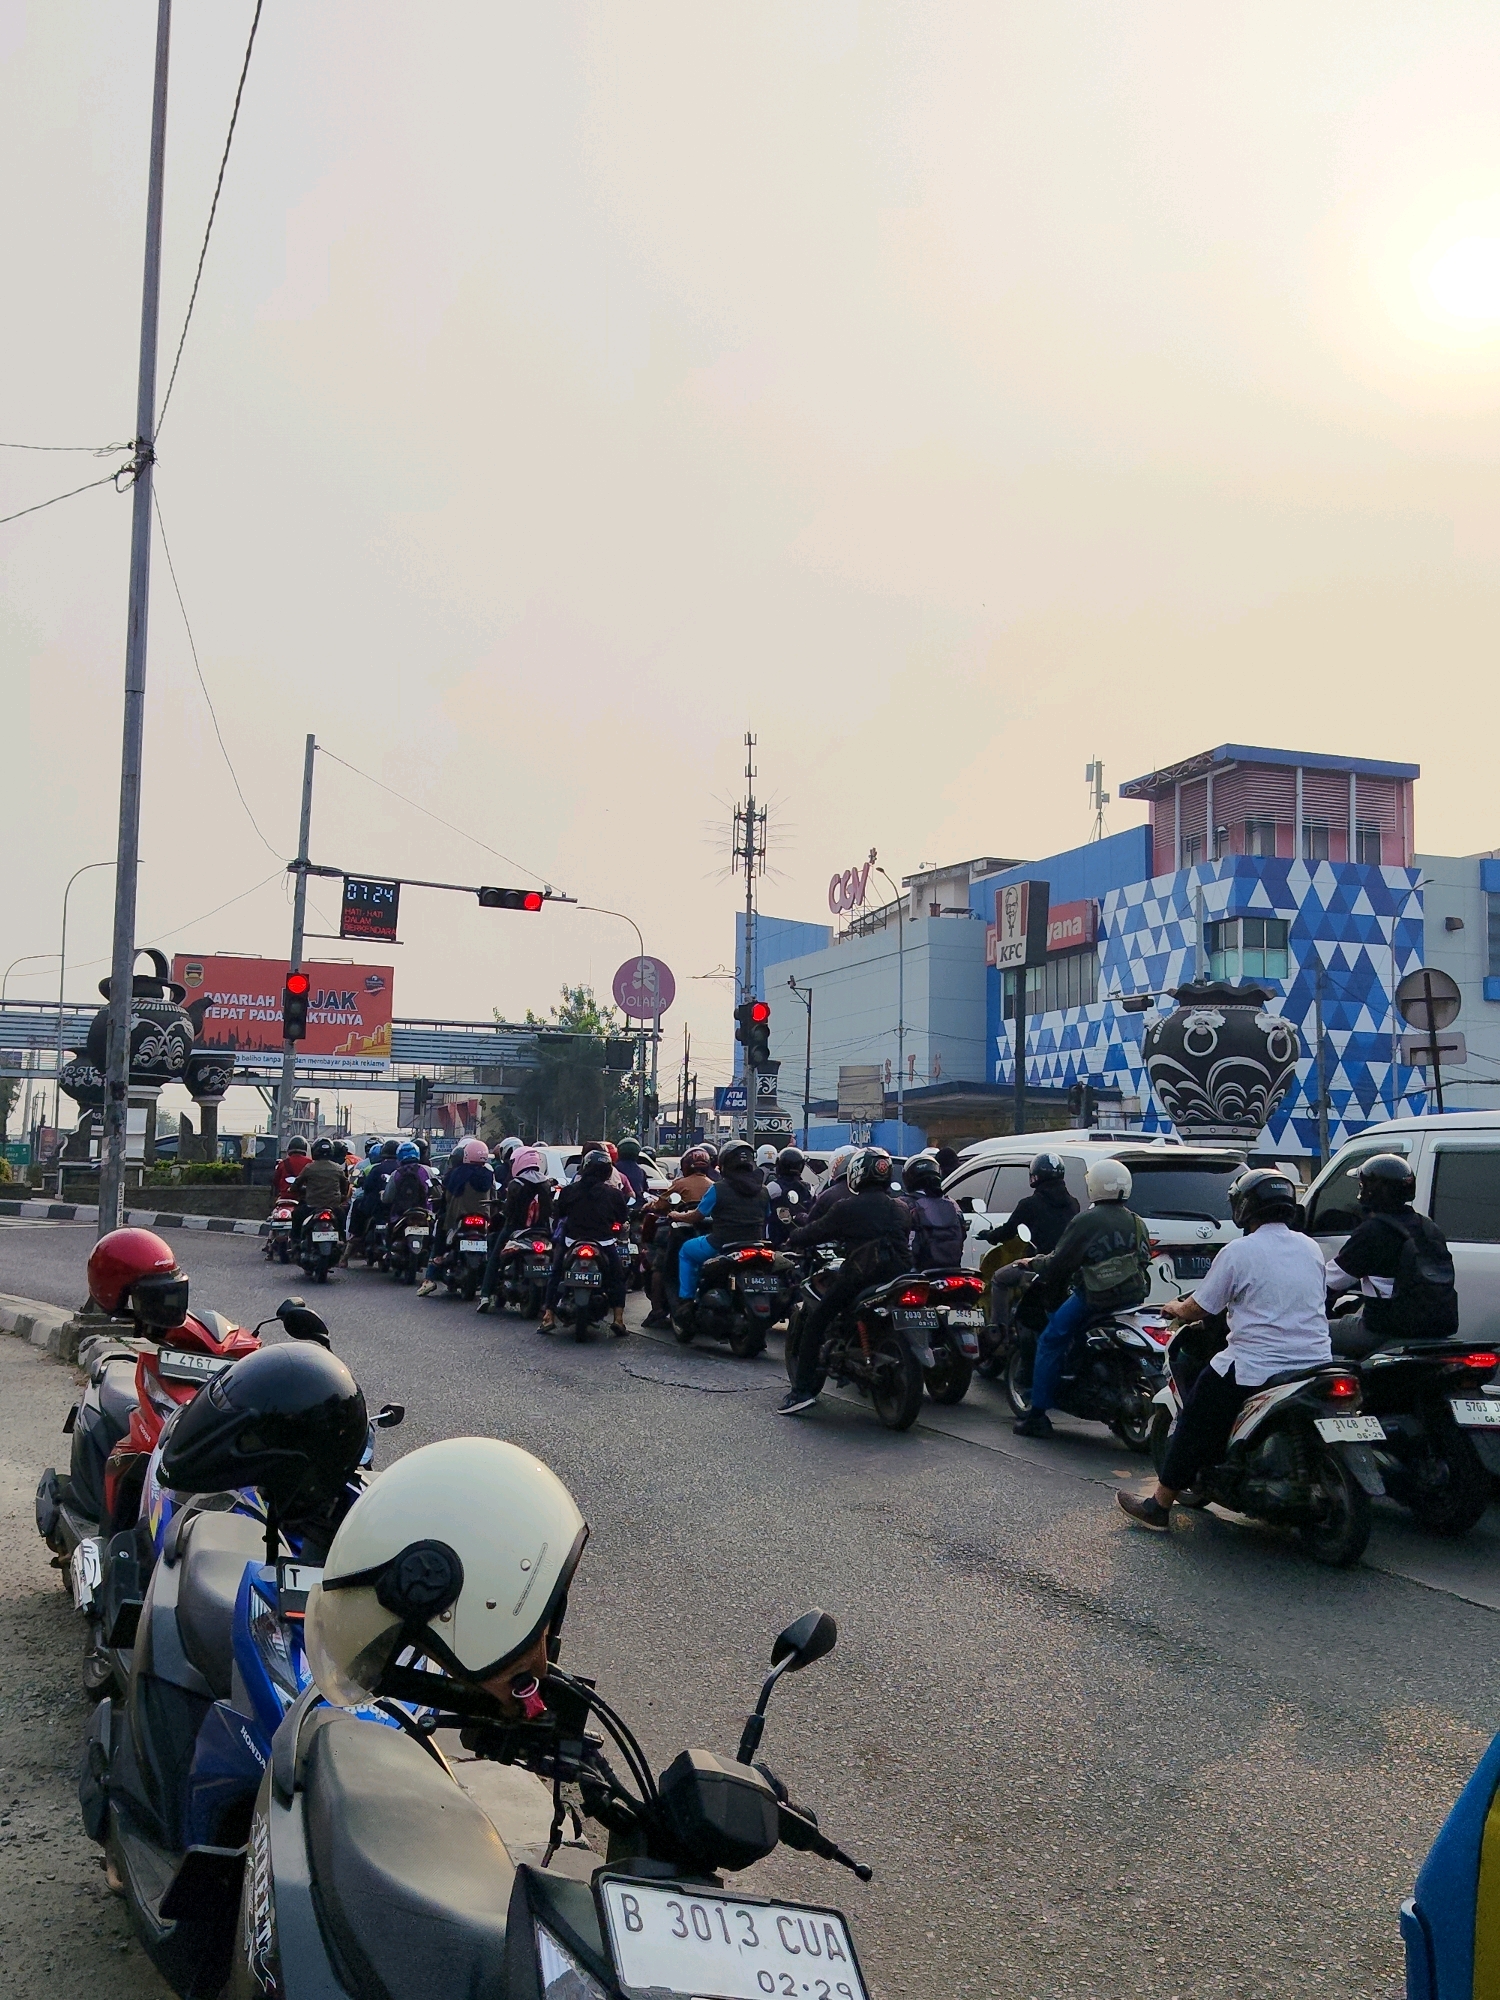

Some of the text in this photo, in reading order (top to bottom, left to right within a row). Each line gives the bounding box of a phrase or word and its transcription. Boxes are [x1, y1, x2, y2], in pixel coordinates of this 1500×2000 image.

[829, 862, 870, 914] CGV
[1000, 943, 1022, 963] KFC
[619, 982, 668, 1009] SOLAA
[204, 1006, 363, 1026] TEPAT PADA KTUNYA
[242, 1054, 261, 1063] baliho
[263, 1055, 281, 1064] tanpa
[307, 1057, 341, 1066] membayar
[360, 1059, 385, 1068] reklame
[727, 1091, 744, 1099] ATM
[1177, 1257, 1211, 1269] T 1709
[164, 1352, 212, 1370] T 4767
[1452, 1400, 1459, 1411] T
[1465, 1401, 1488, 1412] 5703
[1317, 1421, 1325, 1431] T
[1364, 1418, 1379, 1428] CE
[289, 1567, 301, 1588] T
[240, 1725, 266, 1771] HONDA
[620, 1892, 848, 1963] B 3013 CUA
